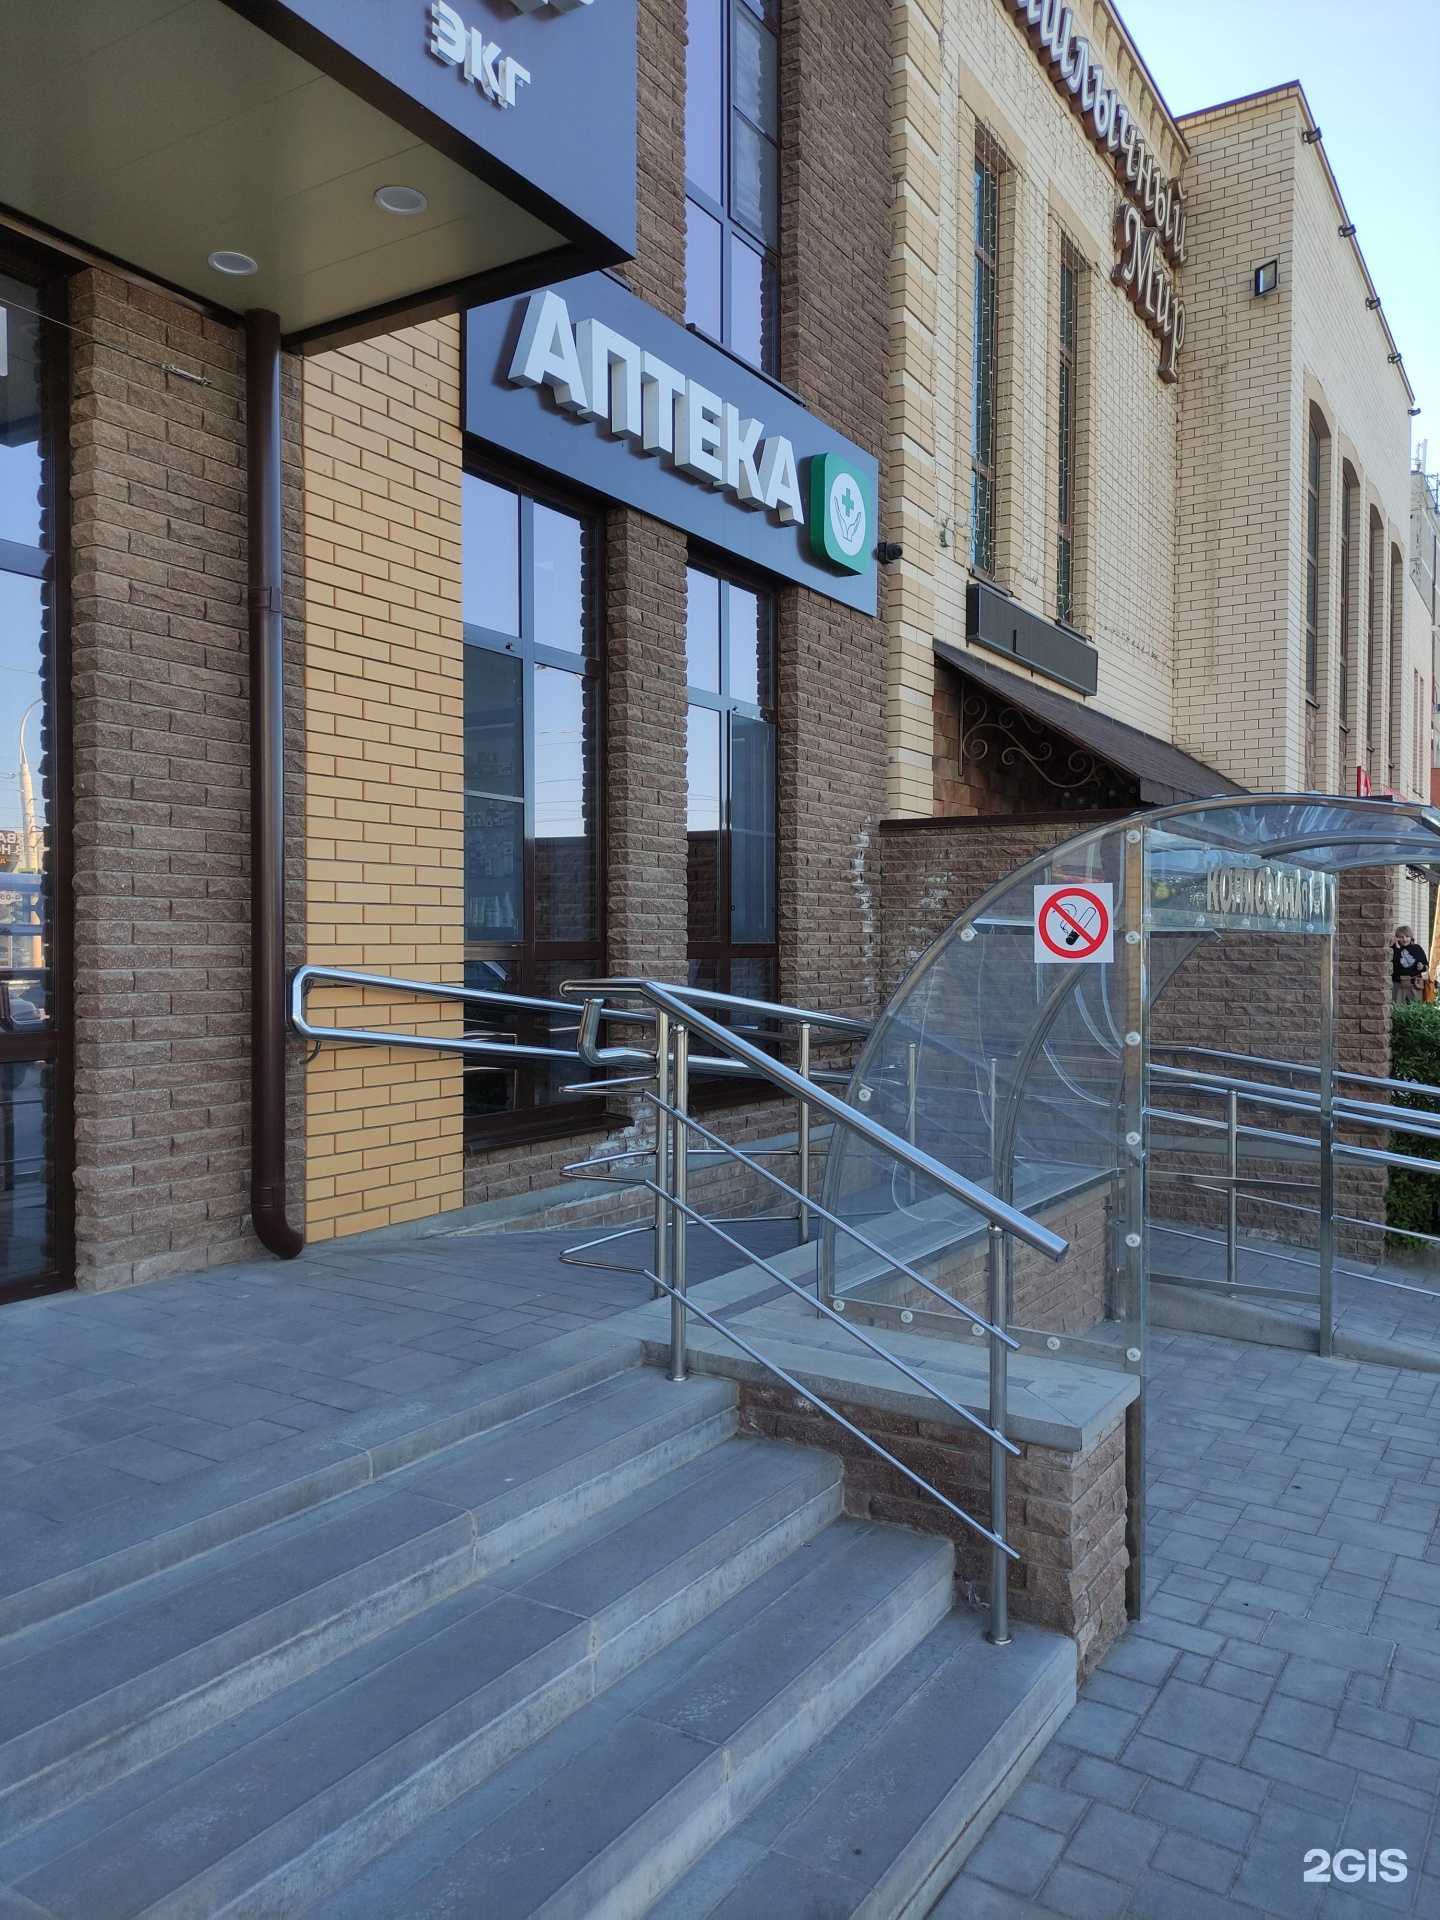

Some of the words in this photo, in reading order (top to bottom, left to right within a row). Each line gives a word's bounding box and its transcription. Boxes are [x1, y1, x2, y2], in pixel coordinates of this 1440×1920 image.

[431, 0, 531, 109] ЭКГ
[1112, 203, 1187, 383] Мир
[507, 289, 805, 527] АПТЕКА
